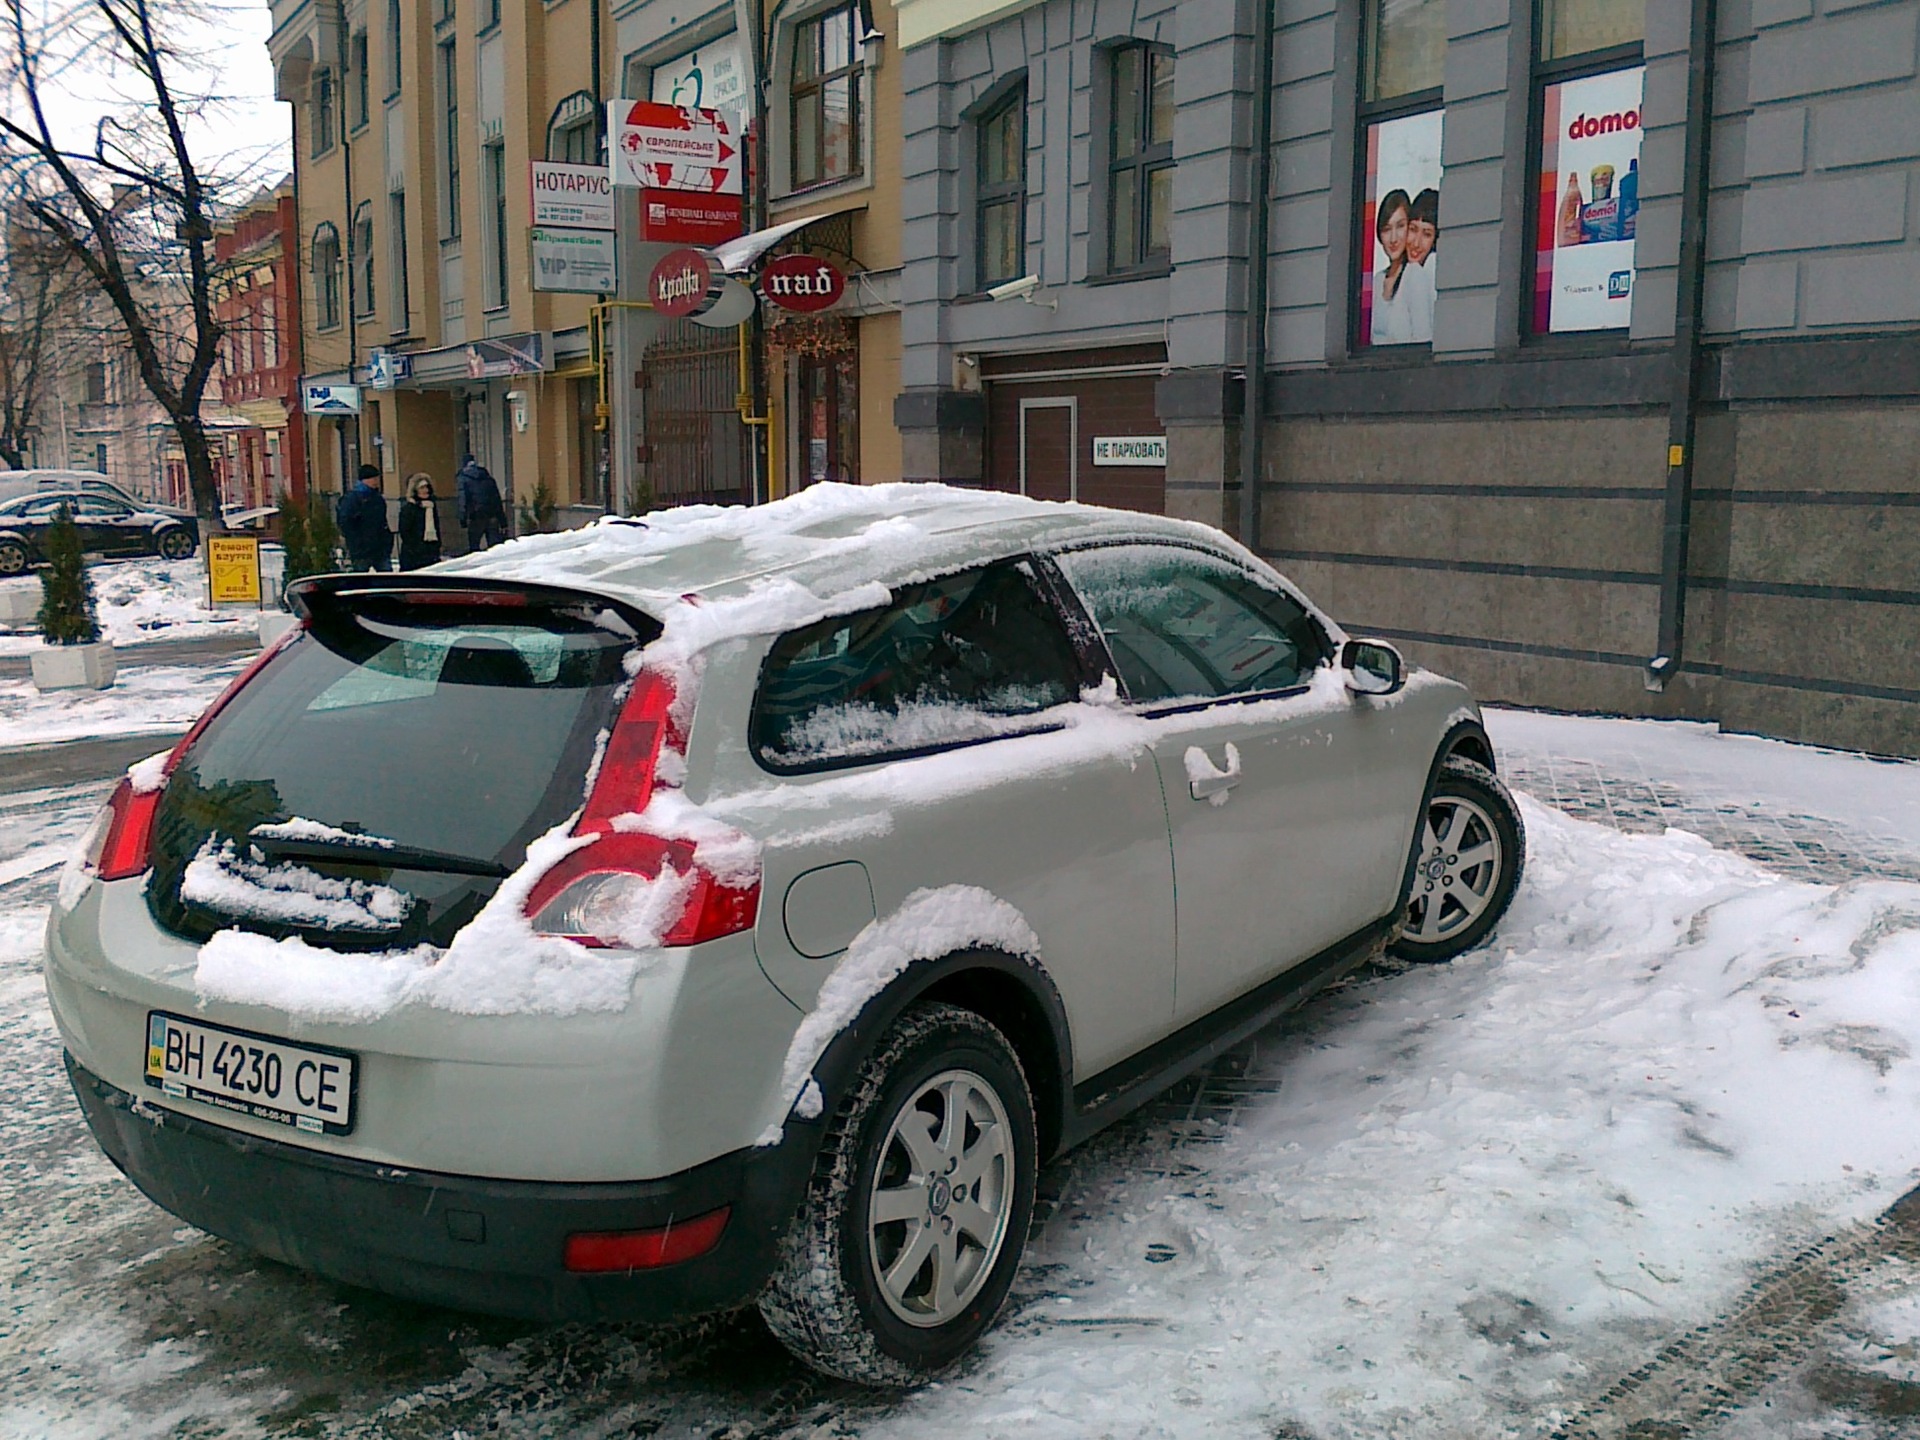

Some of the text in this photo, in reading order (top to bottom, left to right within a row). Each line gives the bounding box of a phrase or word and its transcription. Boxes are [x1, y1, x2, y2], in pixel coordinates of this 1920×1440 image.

[536, 171, 610, 196] НОТАРІУС
[539, 257, 566, 275] VIP
[1096, 442, 1165, 458] НЕ ПАРКОВАТЬ
[213, 542, 254, 551] Ремонт
[216, 553, 253, 562] взуття
[150, 1055, 162, 1069] UA
[166, 1027, 340, 1113] BH 4230 CE
